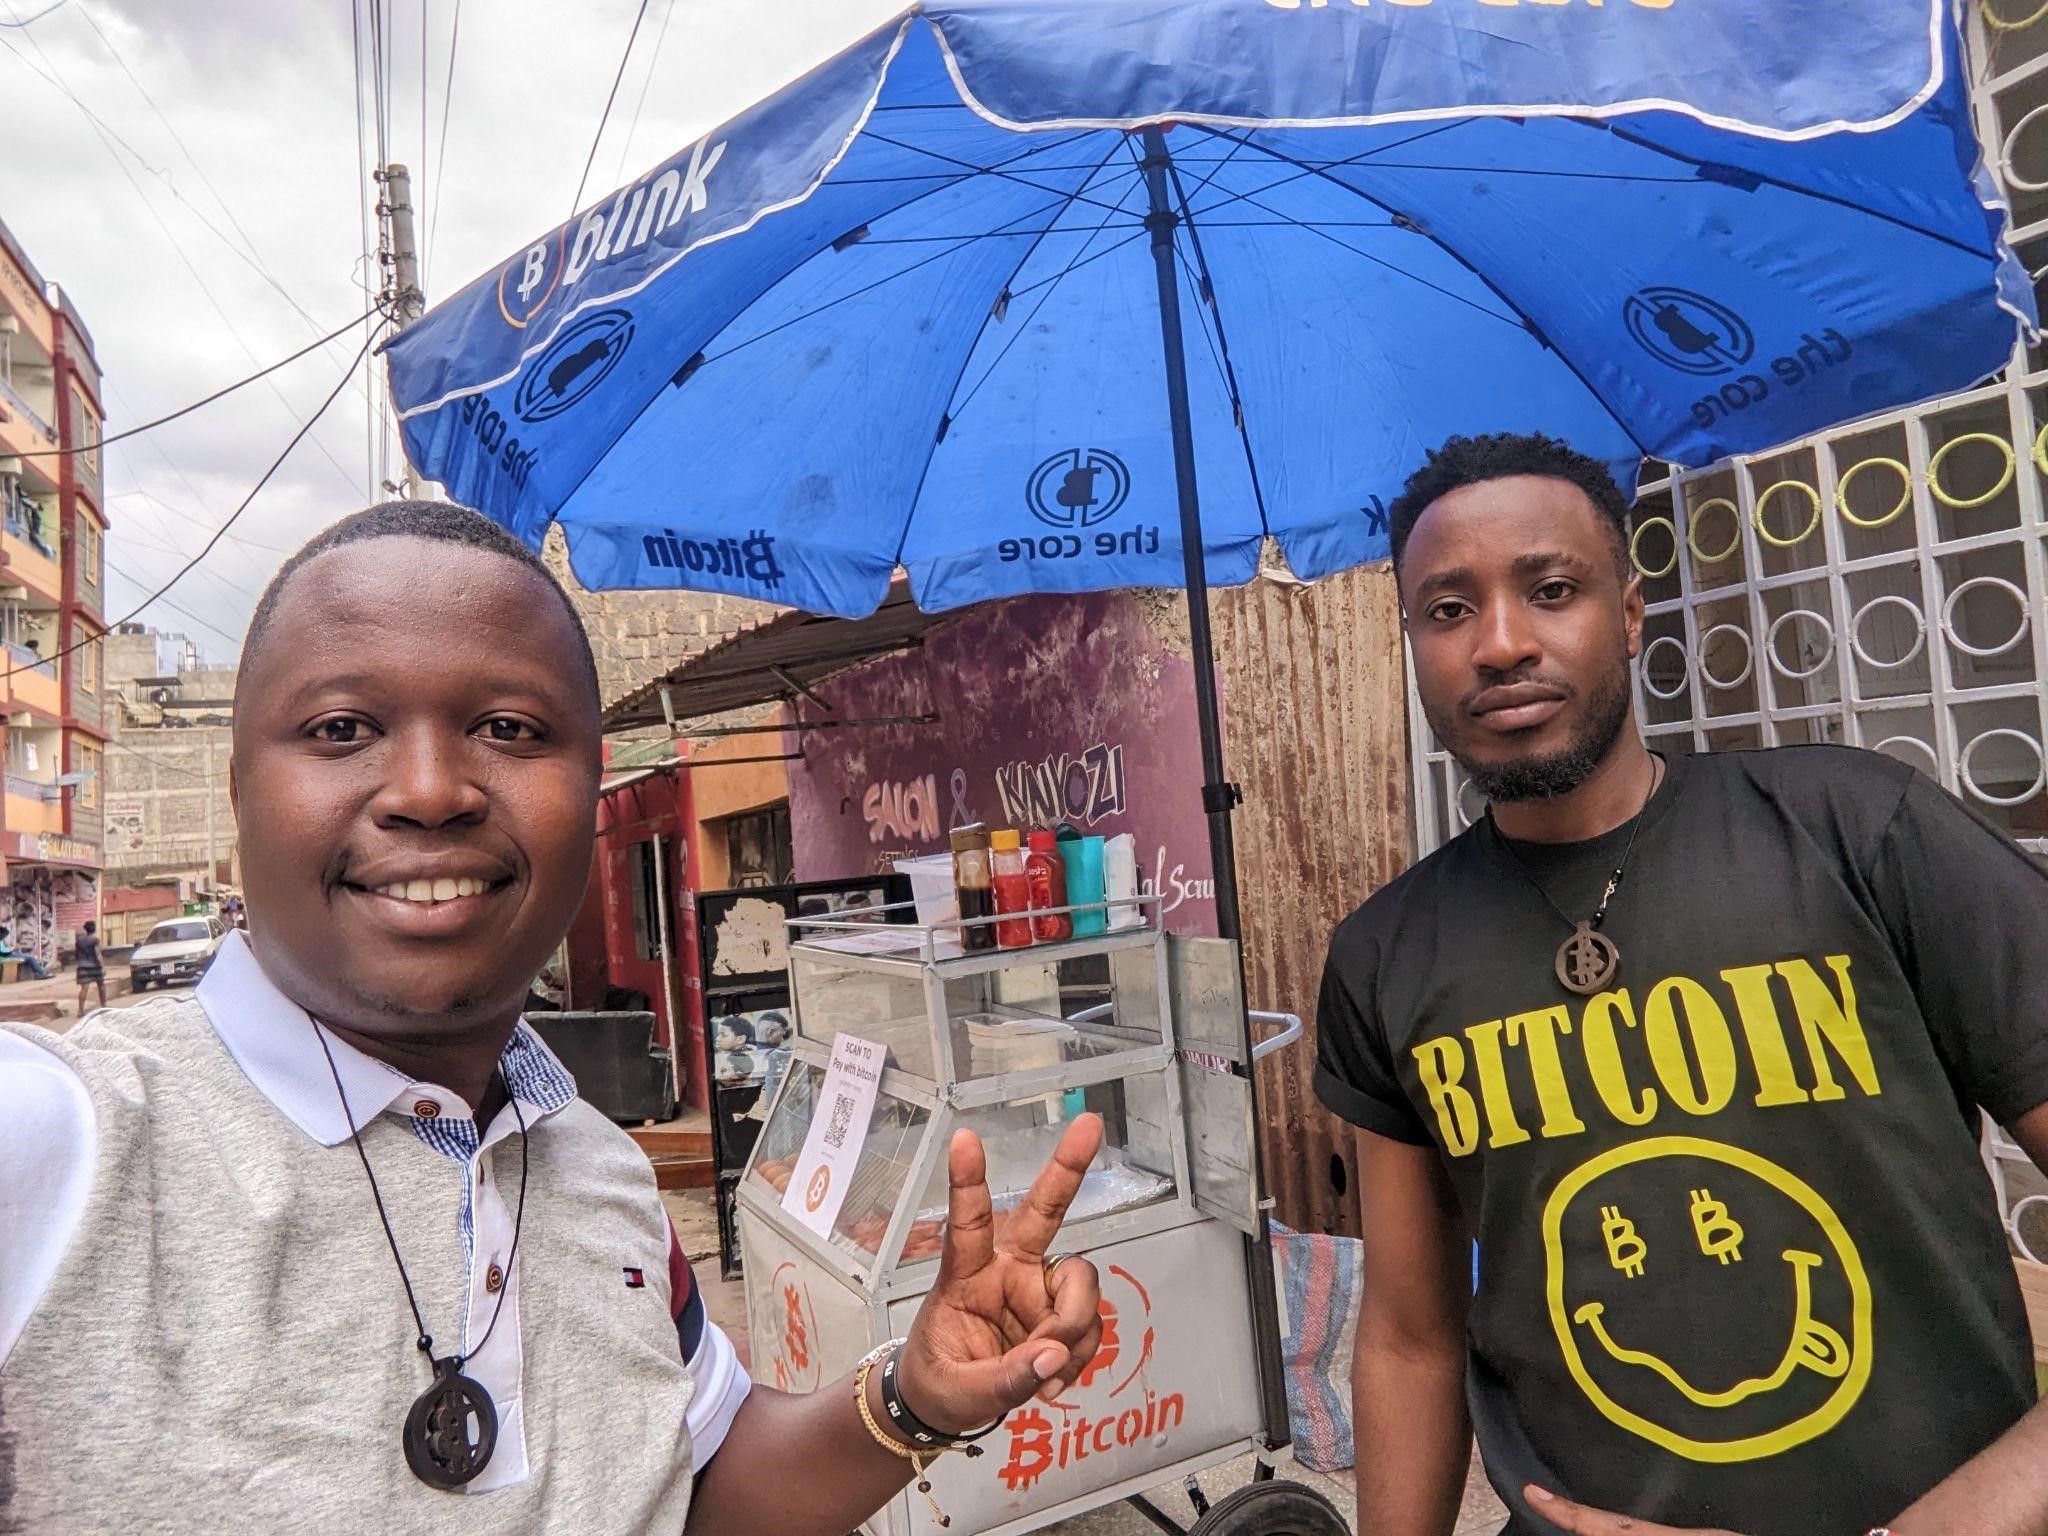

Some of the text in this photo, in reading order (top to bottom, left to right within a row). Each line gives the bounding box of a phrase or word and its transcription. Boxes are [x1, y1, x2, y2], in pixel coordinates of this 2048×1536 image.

[562, 134, 728, 286] blink
[862, 773, 941, 844] SALON
[1162, 863, 1214, 912] Scru
[833, 1057, 843, 1072] Pay
[844, 1062, 856, 1075] with
[845, 1042, 871, 1059] SCAN TO
[1411, 954, 1882, 1158] BITCOIN
